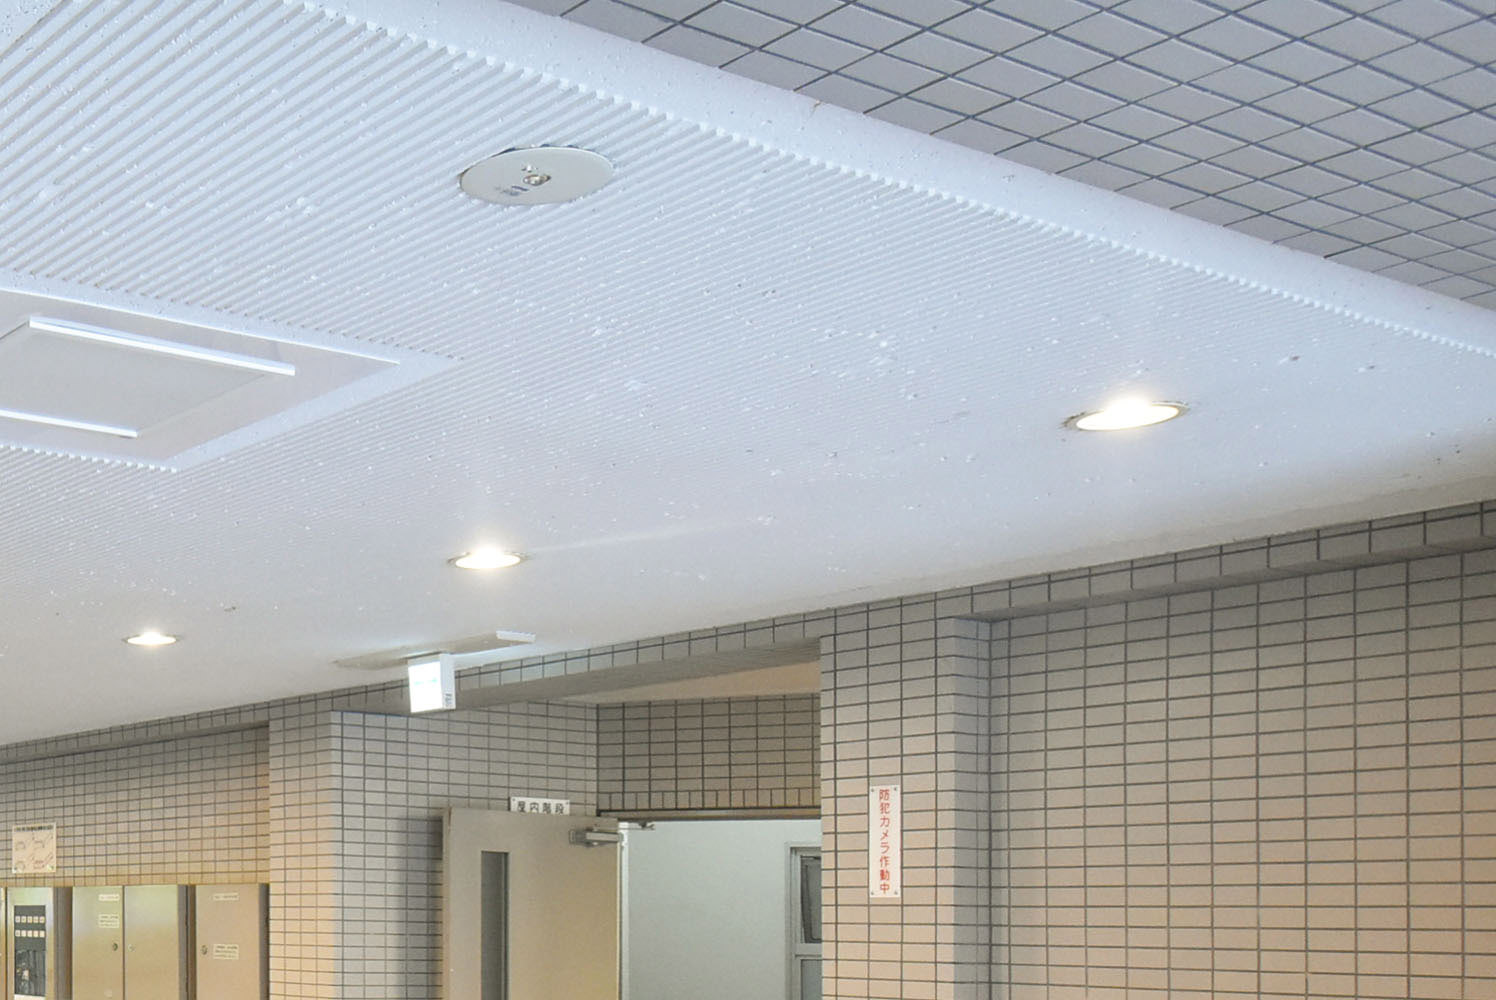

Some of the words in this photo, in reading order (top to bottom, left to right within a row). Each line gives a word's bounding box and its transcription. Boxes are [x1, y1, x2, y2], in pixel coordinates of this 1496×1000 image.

[879, 789, 890, 894] 防犯カメラ作動中
